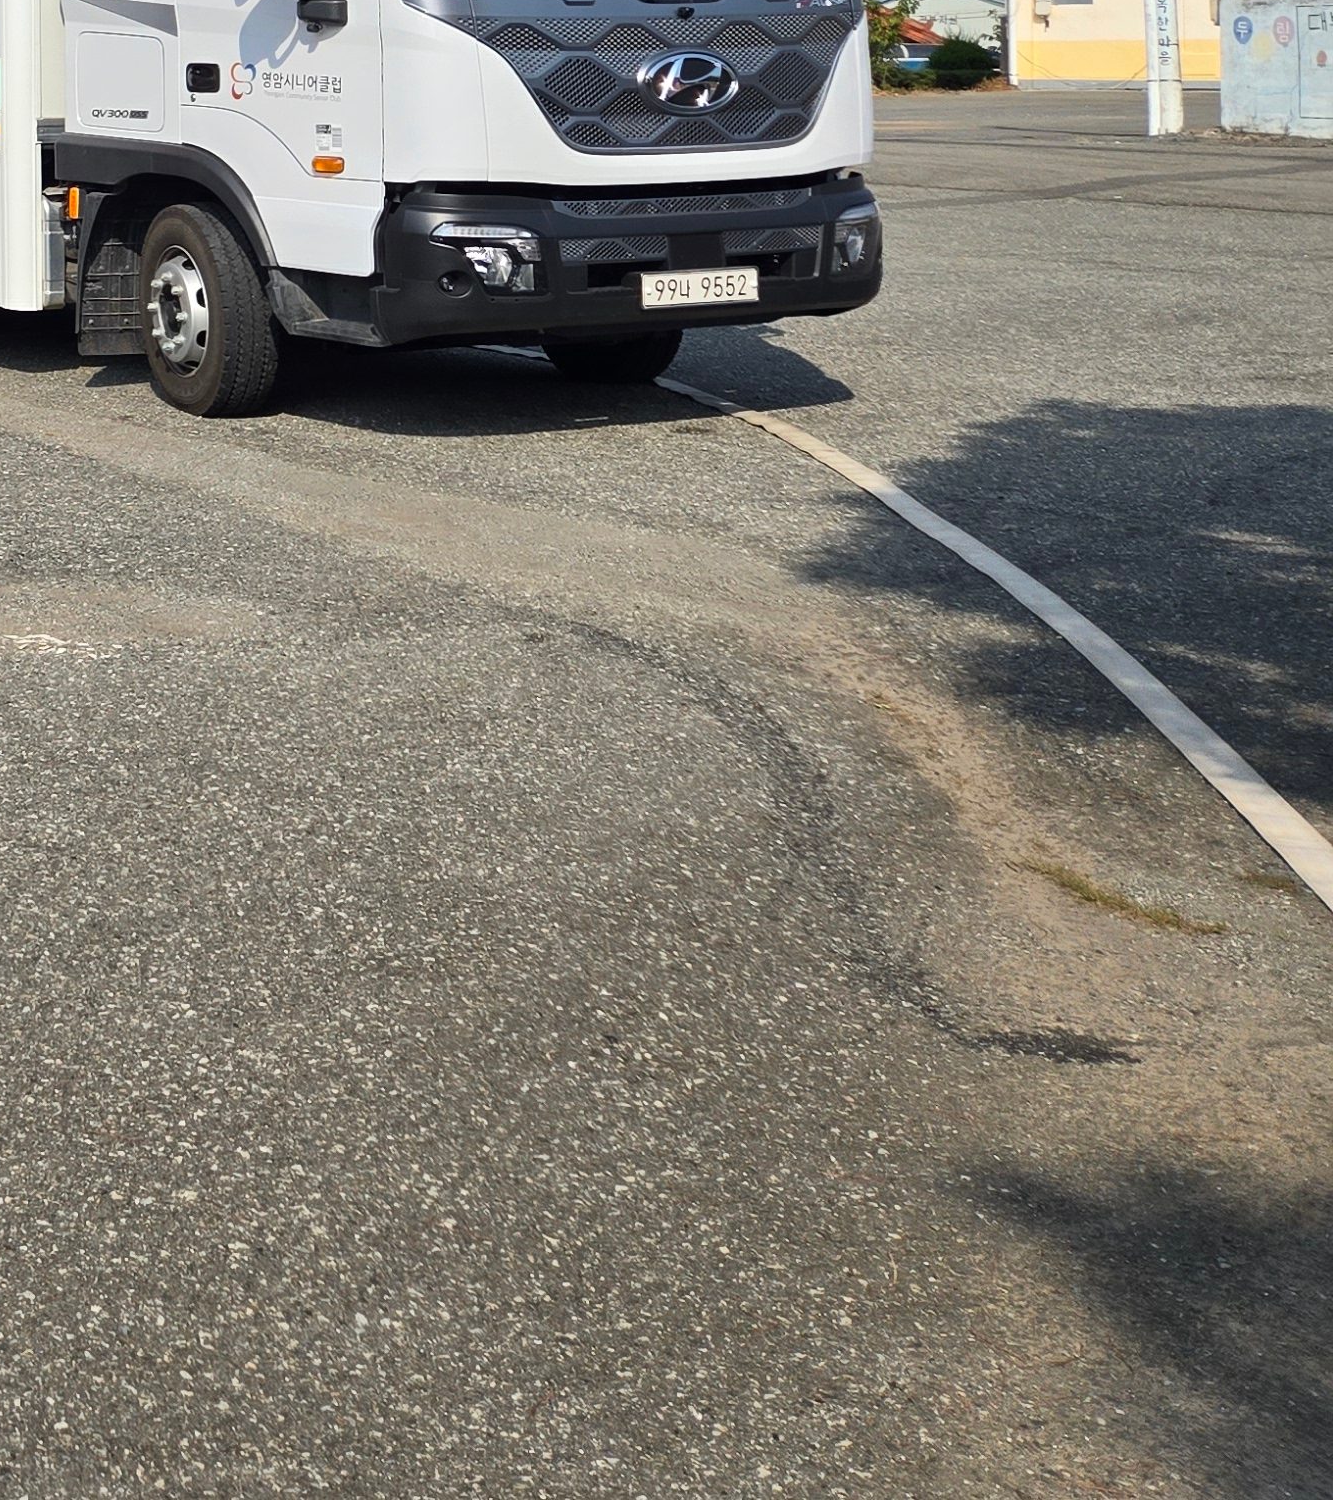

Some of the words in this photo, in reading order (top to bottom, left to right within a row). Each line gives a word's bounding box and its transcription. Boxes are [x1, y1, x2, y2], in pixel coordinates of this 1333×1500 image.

[261, 72, 342, 94] 영암시니어클럽
[92, 109, 129, 118] QV300
[655, 279, 690, 301] 99나
[701, 274, 747, 298] 9552
